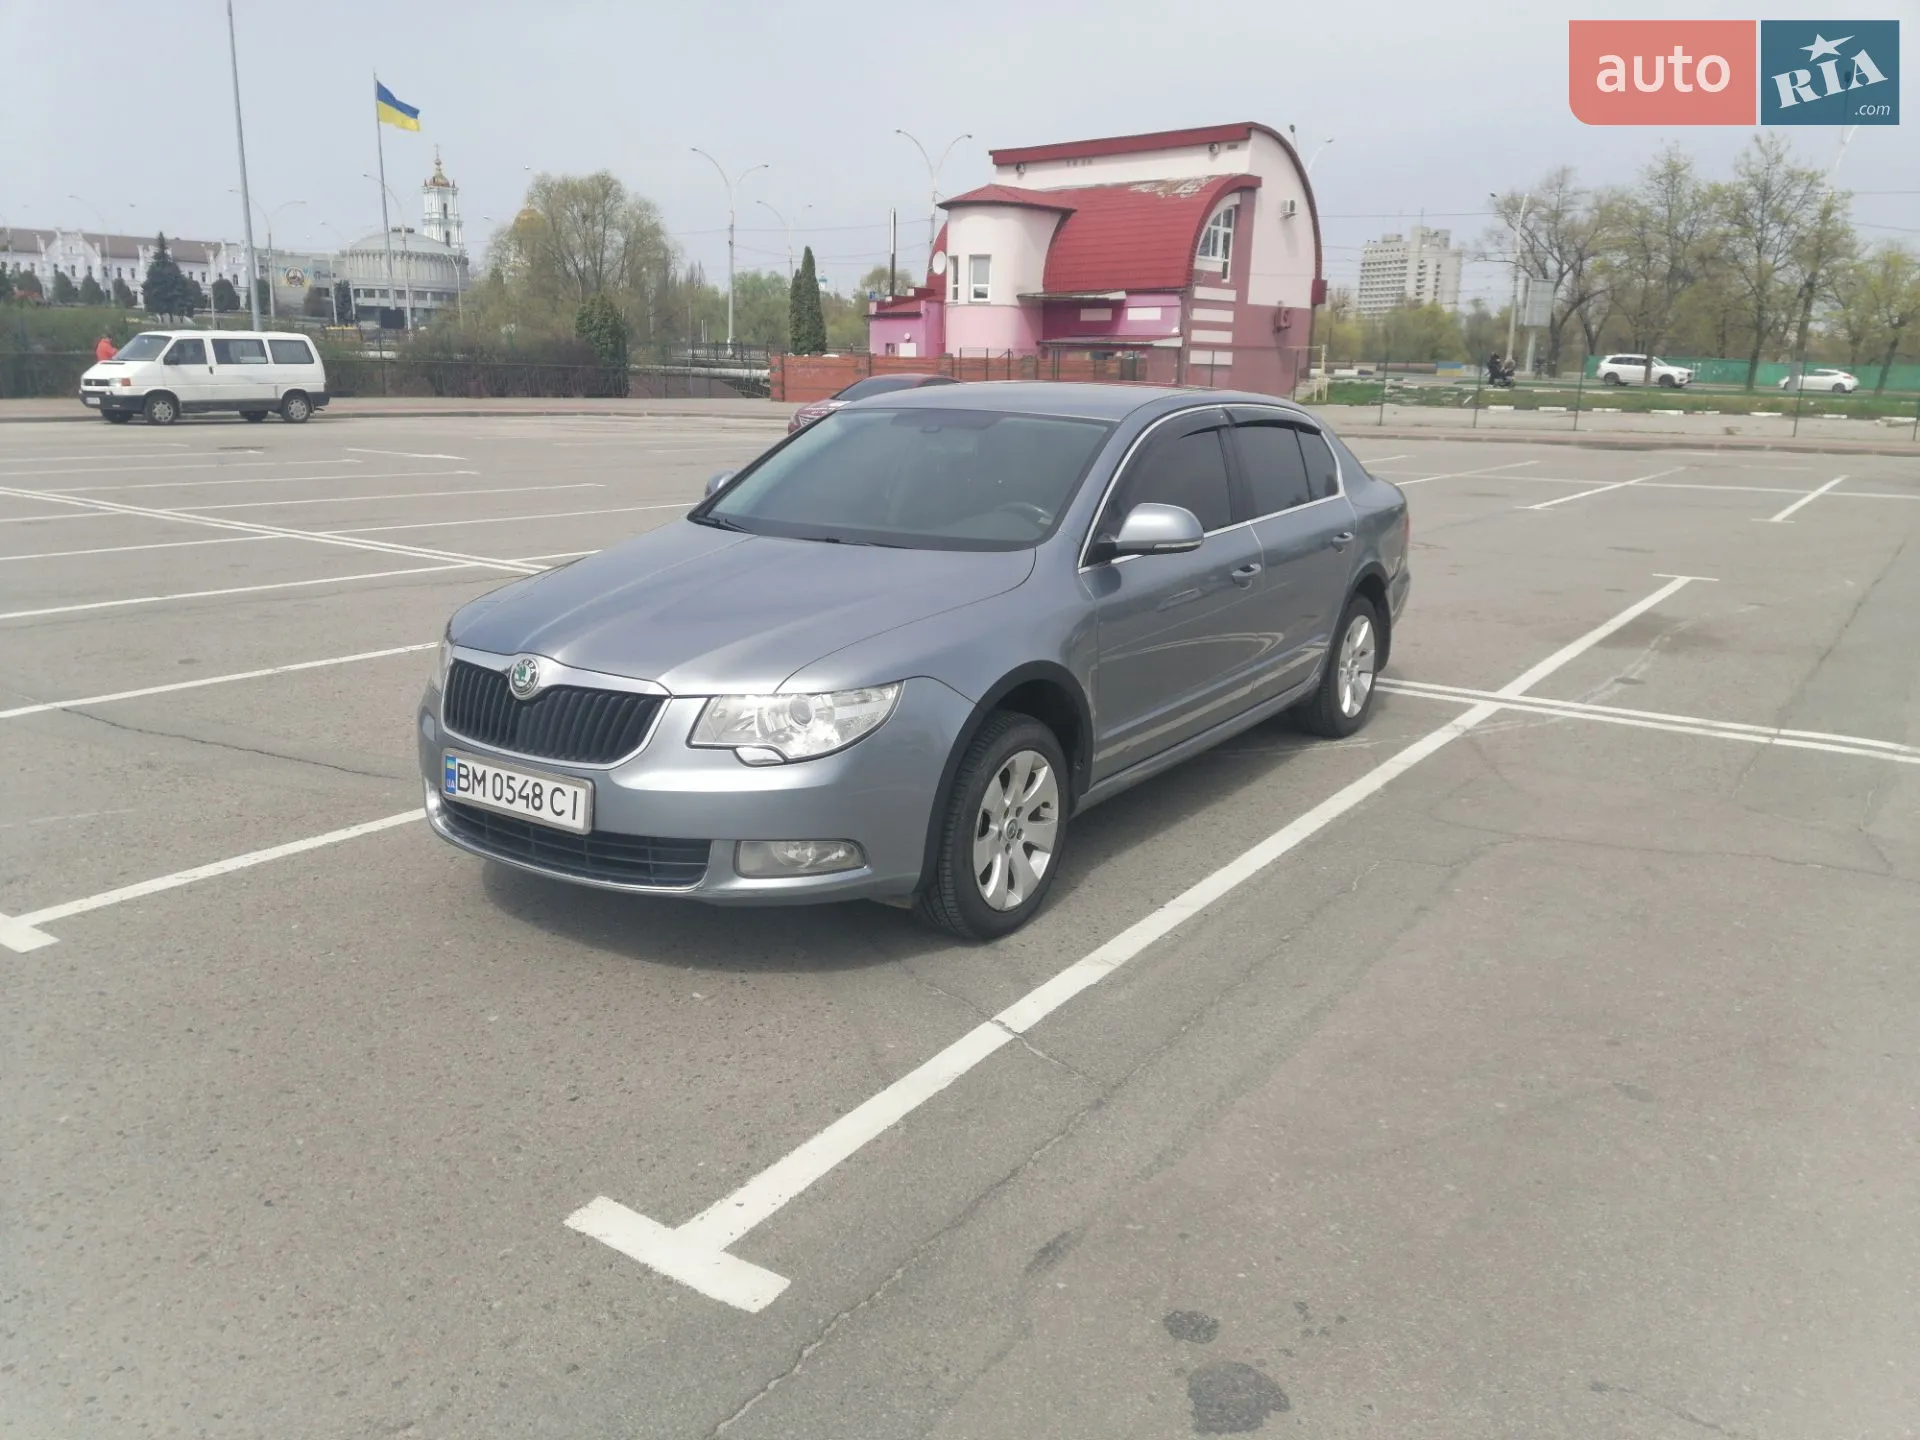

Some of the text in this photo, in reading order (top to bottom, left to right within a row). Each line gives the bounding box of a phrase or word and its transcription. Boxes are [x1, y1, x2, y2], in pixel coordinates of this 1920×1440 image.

[447, 780, 455, 788] UA
[457, 763, 577, 820] BM 0548 CI
